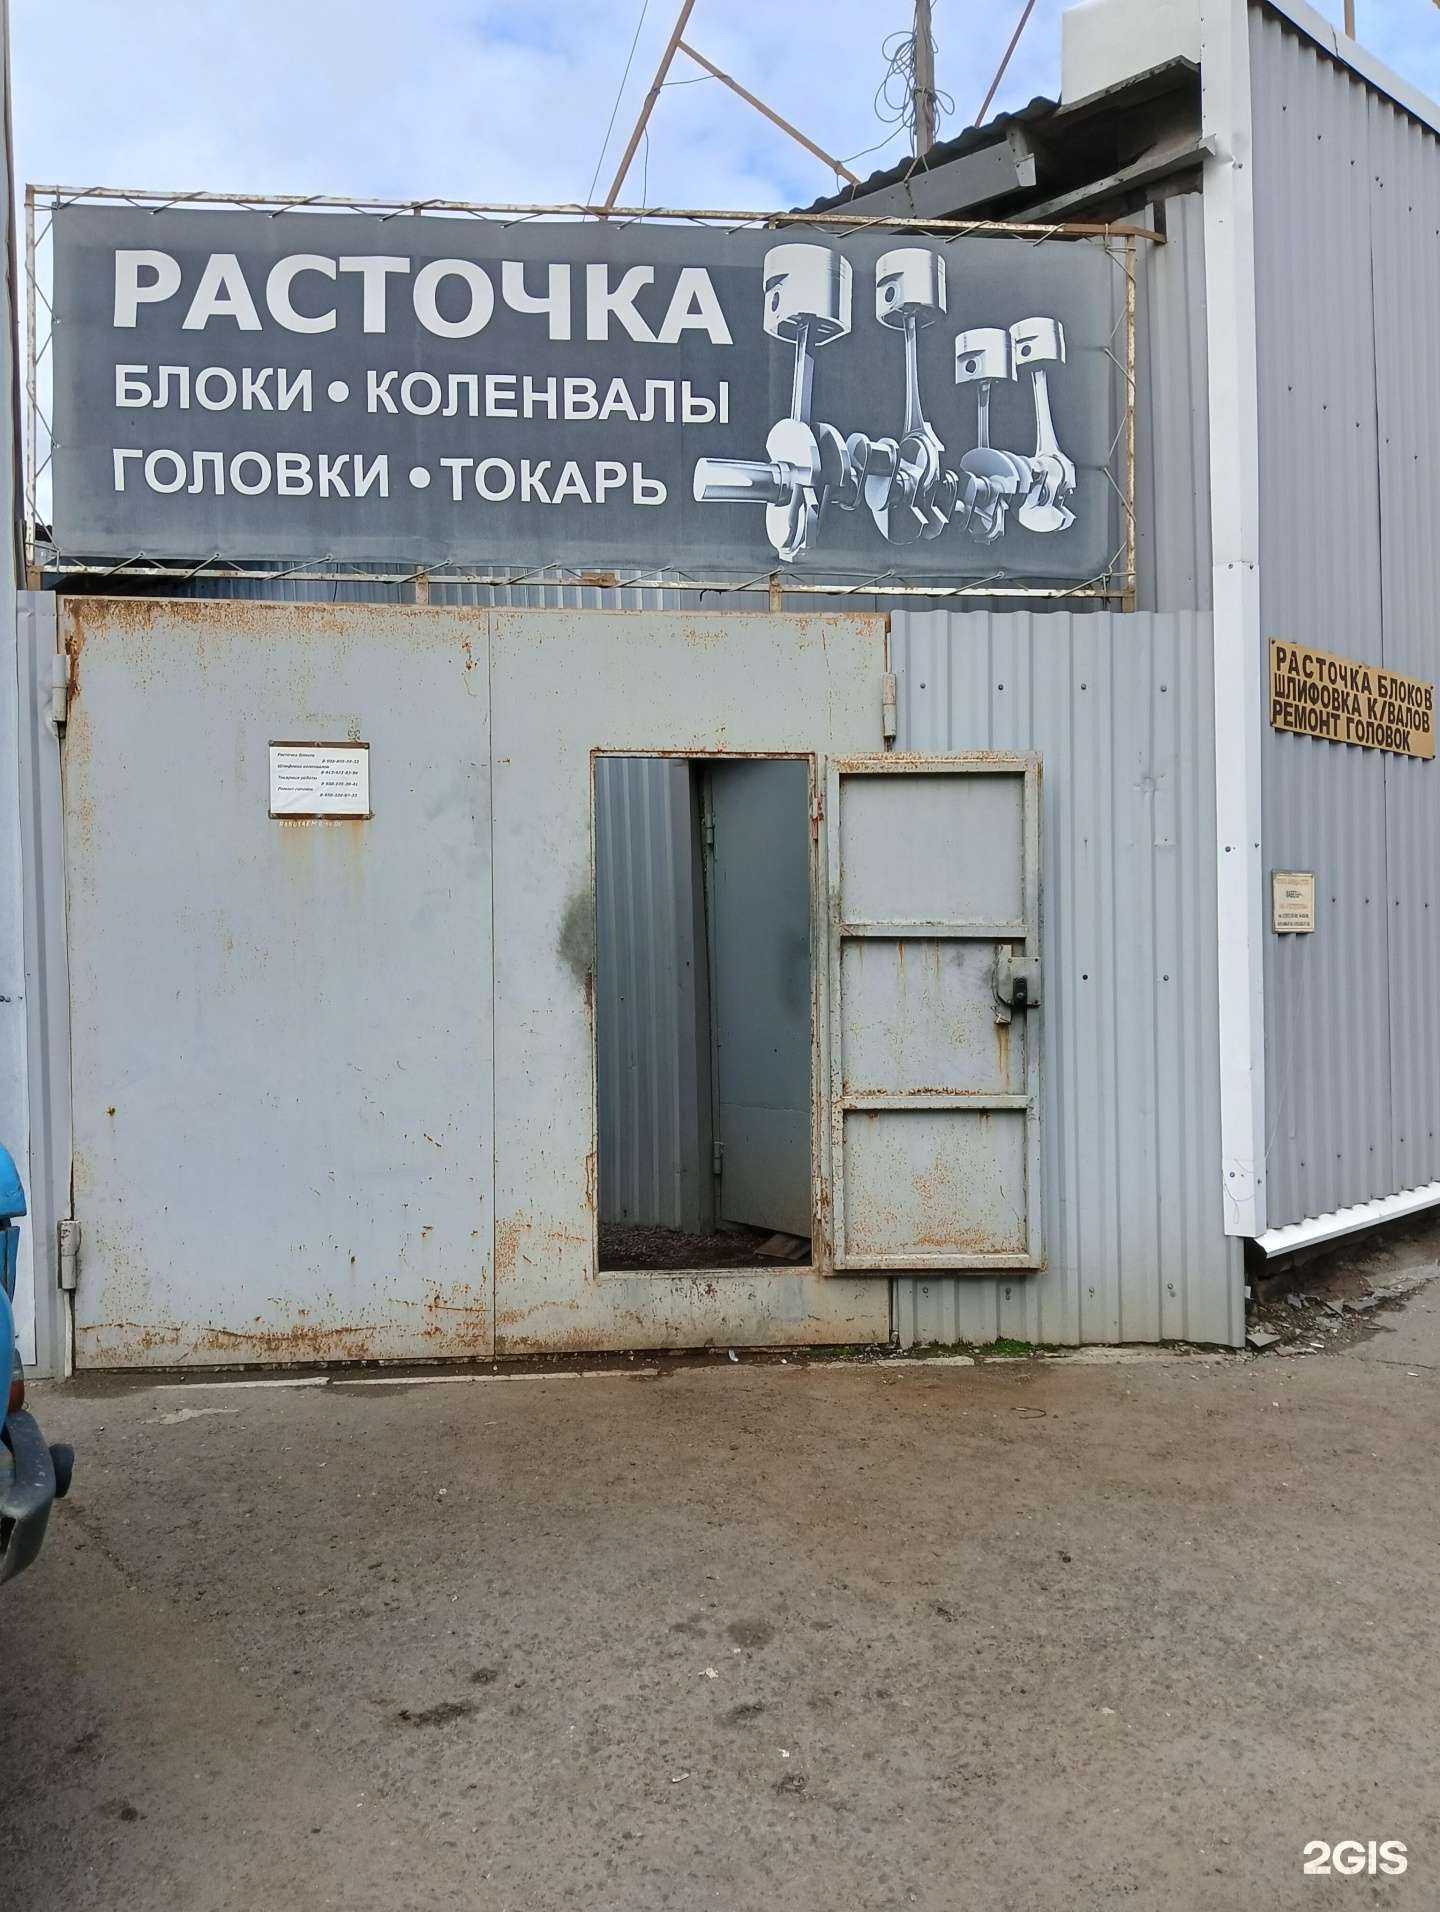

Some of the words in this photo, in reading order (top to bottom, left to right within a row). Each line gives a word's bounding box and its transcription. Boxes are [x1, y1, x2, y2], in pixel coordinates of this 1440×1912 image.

[112, 249, 733, 346] РАСТОЧКА
[115, 364, 314, 412] БЛОКИ
[366, 370, 730, 425] КОЛЕНВАЛЫ
[112, 448, 390, 499] ГОЛОВКИ
[440, 456, 667, 506] ТОКАРЬ
[1274, 672, 1362, 717] ШЛИФОВКА
[1367, 696, 1430, 733] К/ВАЛОВ
[1276, 645, 1373, 696] РАСТОЧКА
[1377, 674, 1433, 711] БЛОКОВ
[1272, 698, 1341, 737] РЕМОНТ
[1346, 715, 1411, 752] ГОЛОВОК
